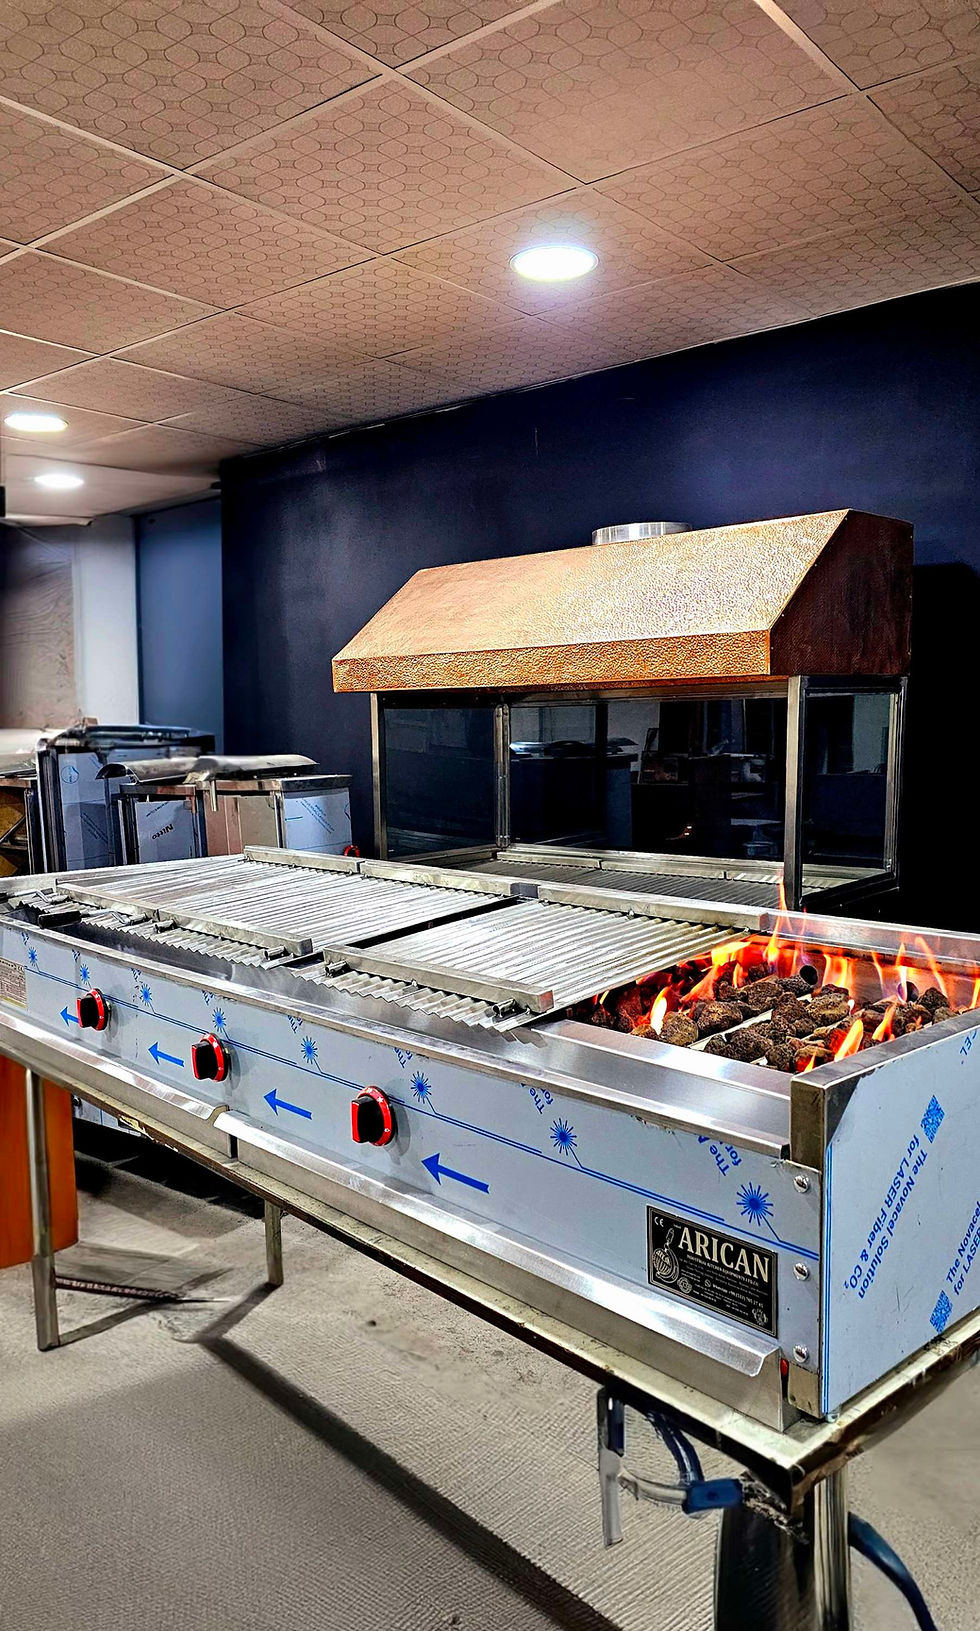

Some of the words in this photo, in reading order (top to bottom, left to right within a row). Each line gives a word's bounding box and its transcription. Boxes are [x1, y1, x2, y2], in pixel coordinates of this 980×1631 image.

[709, 1144, 727, 1177] The
[724, 1145, 742, 1166] for
[906, 1134, 919, 1158] for
[912, 1149, 928, 1176] The
[884, 1157, 910, 1209] LASER
[886, 1175, 915, 1237] Novacel
[867, 1207, 888, 1249] Fiber
[677, 1226, 770, 1283] ARICAN
[858, 1235, 889, 1299] Solution
[860, 1249, 869, 1263] &
[946, 1258, 961, 1284] The
[953, 1273, 965, 1296] for
